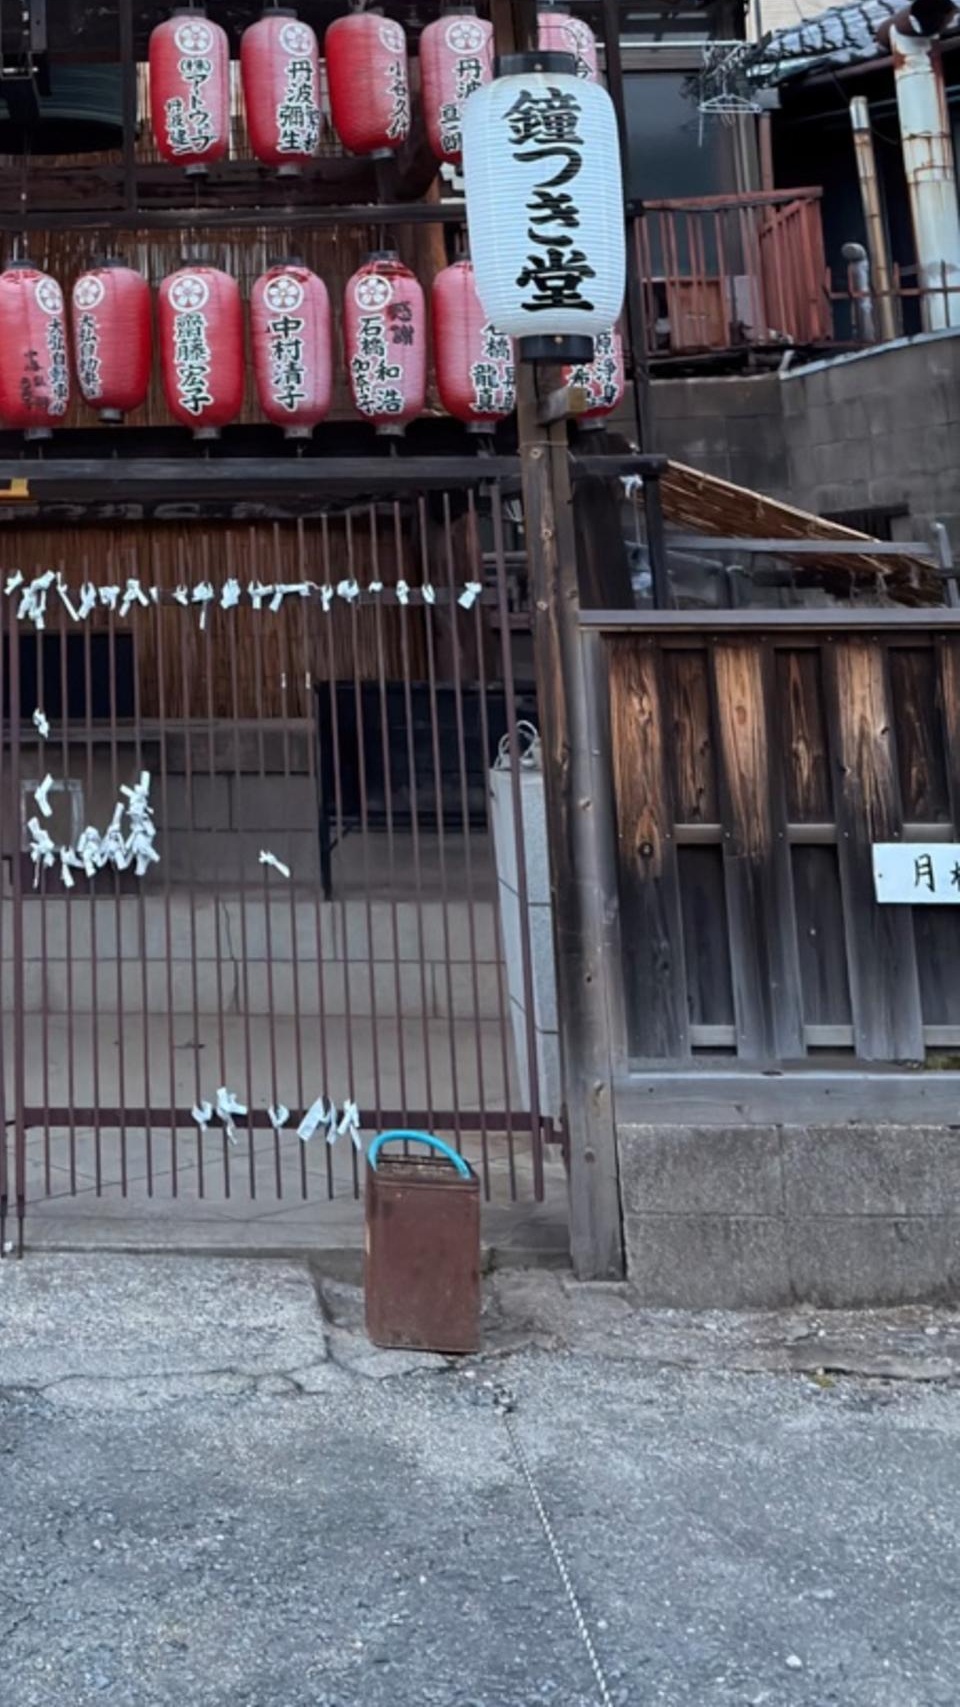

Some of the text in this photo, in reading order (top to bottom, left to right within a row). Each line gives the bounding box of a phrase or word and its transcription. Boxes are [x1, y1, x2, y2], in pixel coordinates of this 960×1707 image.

[502, 87, 595, 311] 鐘つき堂
[269, 314, 306, 411] 中村清子
